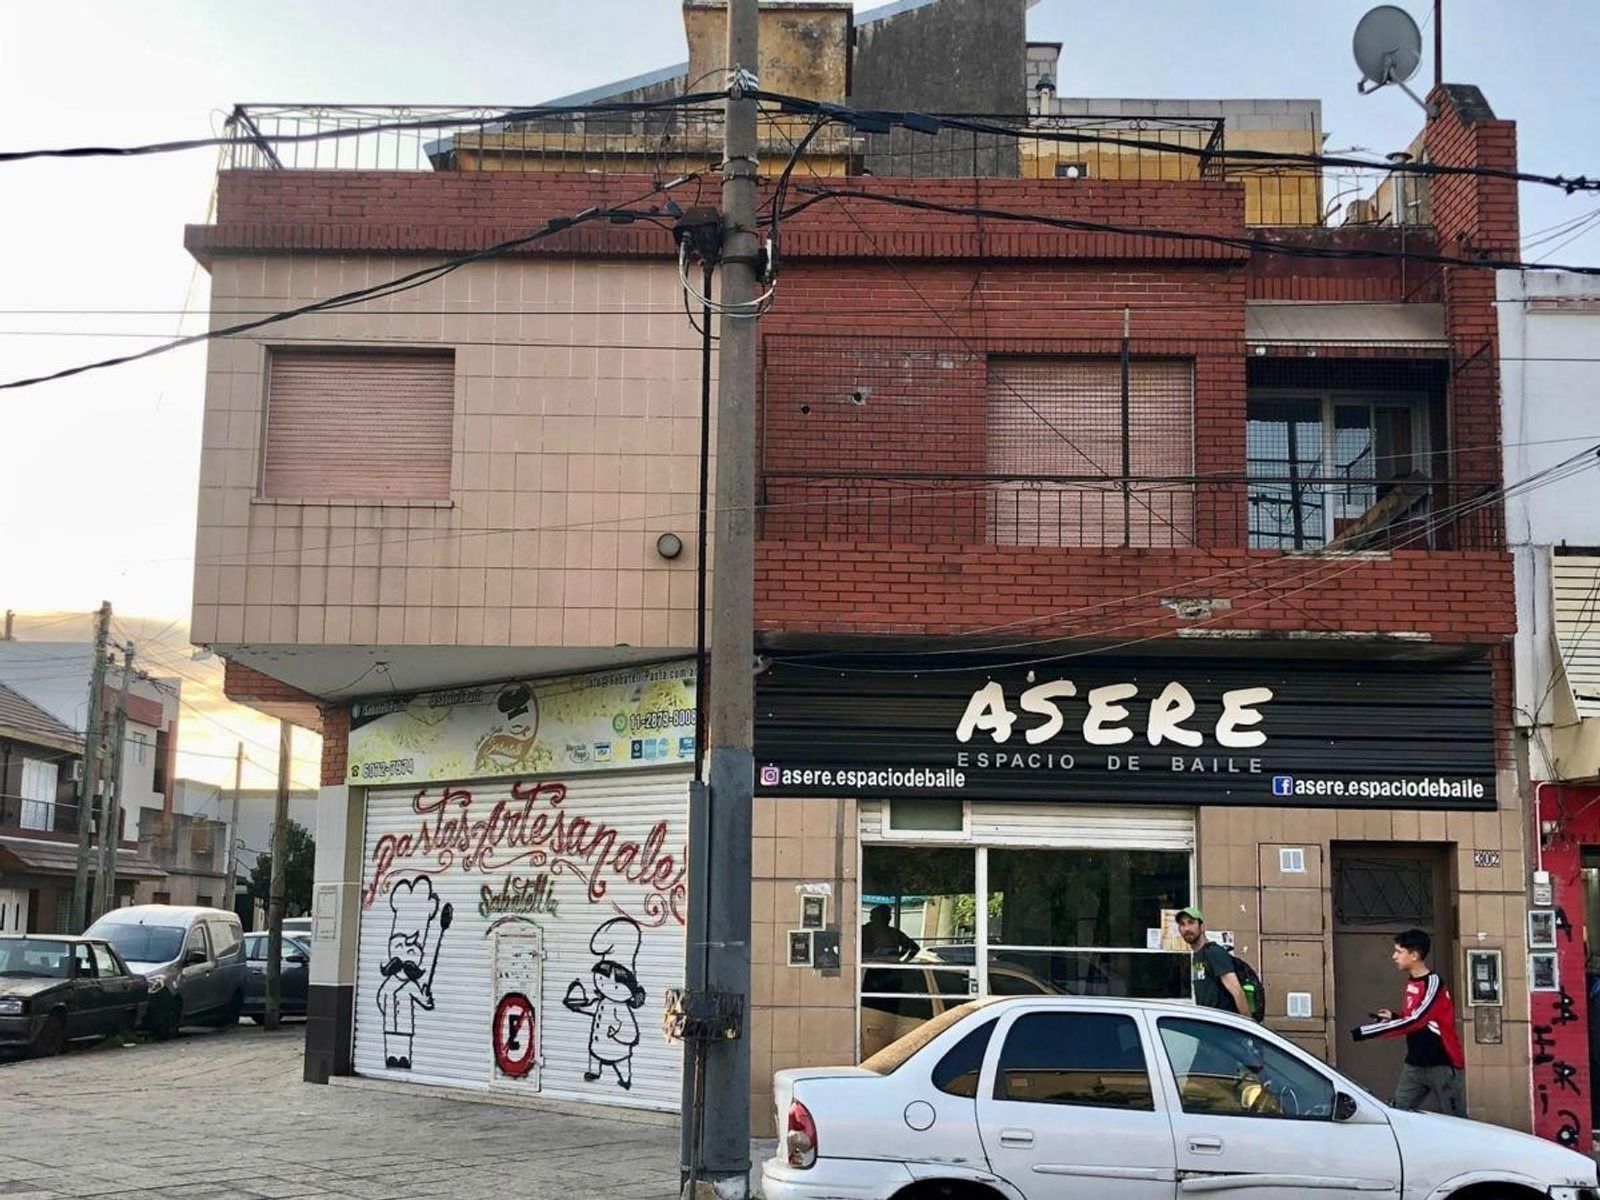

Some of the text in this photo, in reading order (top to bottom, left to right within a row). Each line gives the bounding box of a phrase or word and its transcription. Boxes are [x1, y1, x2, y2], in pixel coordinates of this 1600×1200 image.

[956, 680, 1273, 747] ASERE
[957, 752, 1262, 773] ESPACIO DE BAILE
[782, 767, 966, 789] asere.espaciodebaile
[1294, 777, 1484, 799] asere.espaciodebaile
[1474, 850, 1500, 867] 302
